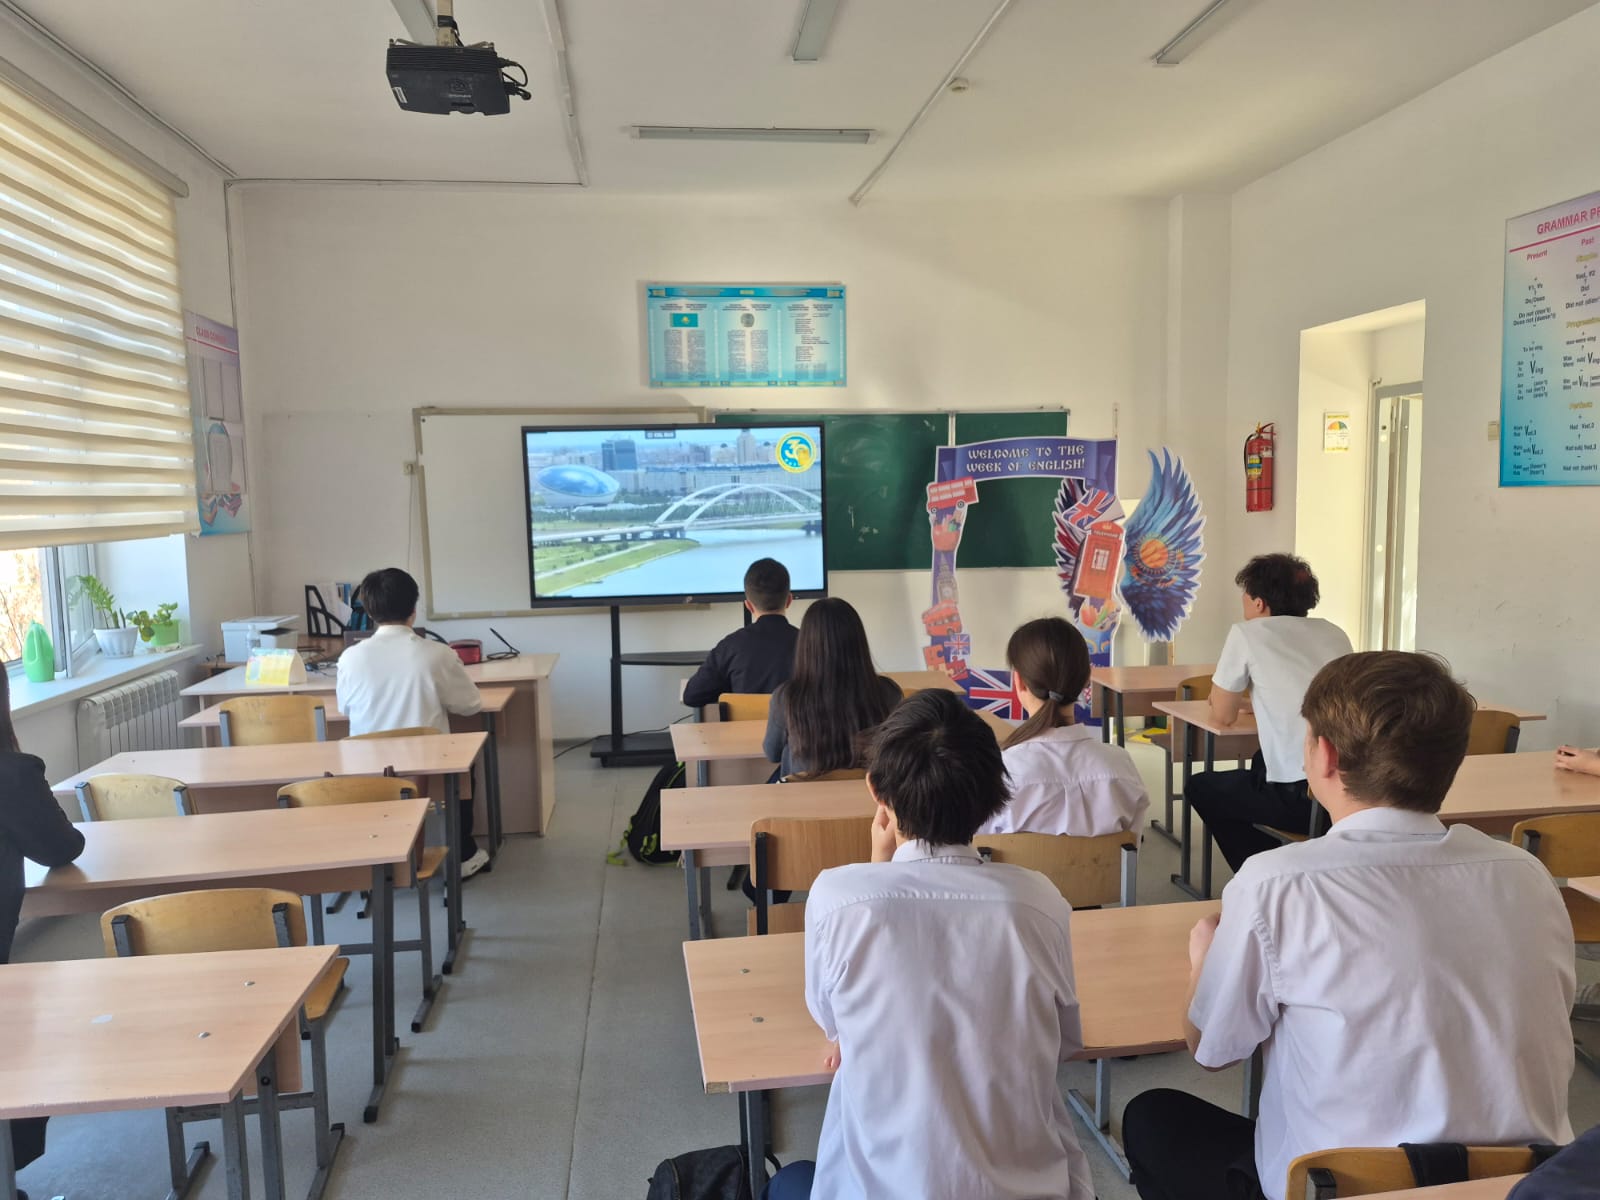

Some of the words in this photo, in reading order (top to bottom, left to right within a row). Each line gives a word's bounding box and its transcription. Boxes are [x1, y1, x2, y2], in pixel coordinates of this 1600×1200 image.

[1537, 210, 1588, 235] GRAMMAR
[1581, 236, 1595, 246] Past
[1526, 249, 1548, 261] Present
[967, 447, 1030, 460] WELCOME
[1035, 447, 1052, 457] TO
[1057, 444, 1085, 456] THE
[966, 461, 1002, 473] WEEK
[1007, 461, 1021, 471] OF
[1028, 458, 1085, 472] ENGLISH!
